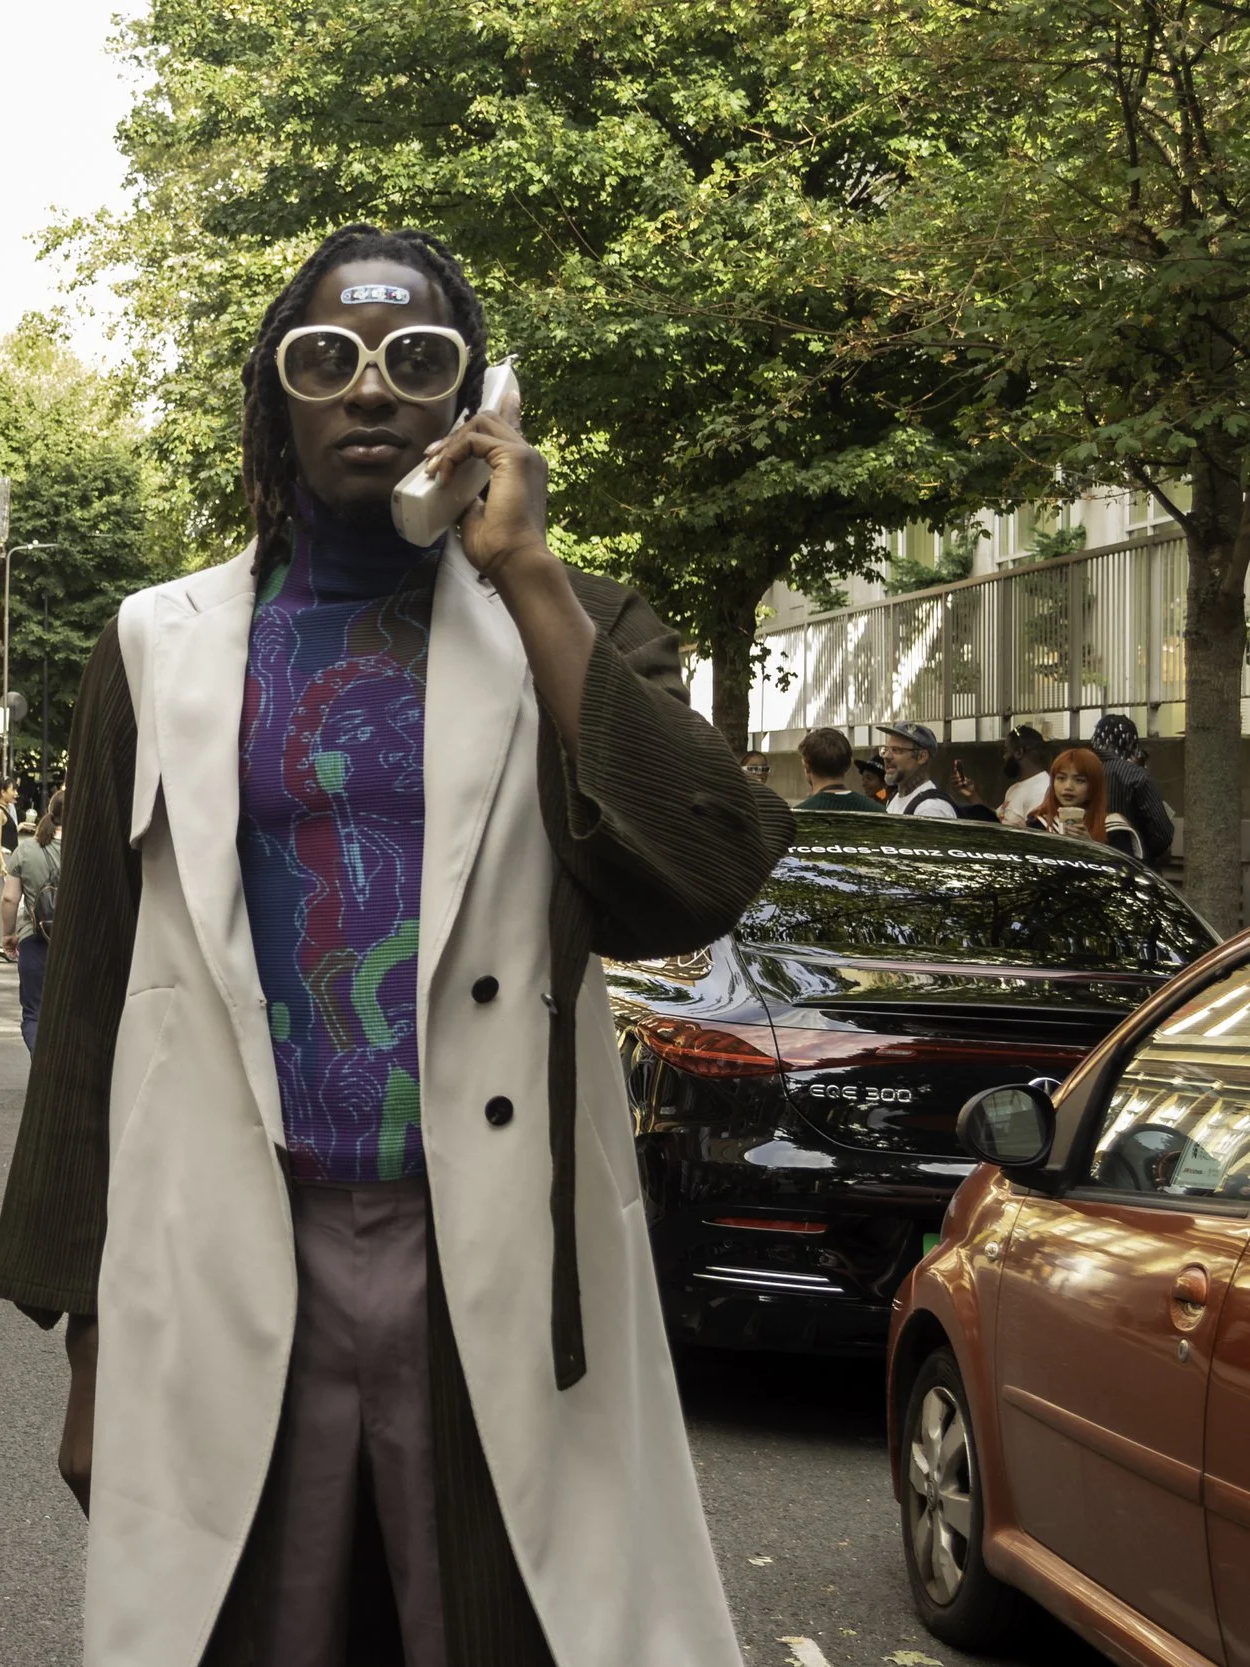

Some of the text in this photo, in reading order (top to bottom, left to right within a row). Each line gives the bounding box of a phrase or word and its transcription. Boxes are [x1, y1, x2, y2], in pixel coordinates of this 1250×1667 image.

[787, 844, 1117, 873] rcedes-Benz Guest Service
[810, 1084, 912, 1103] EQE 300
